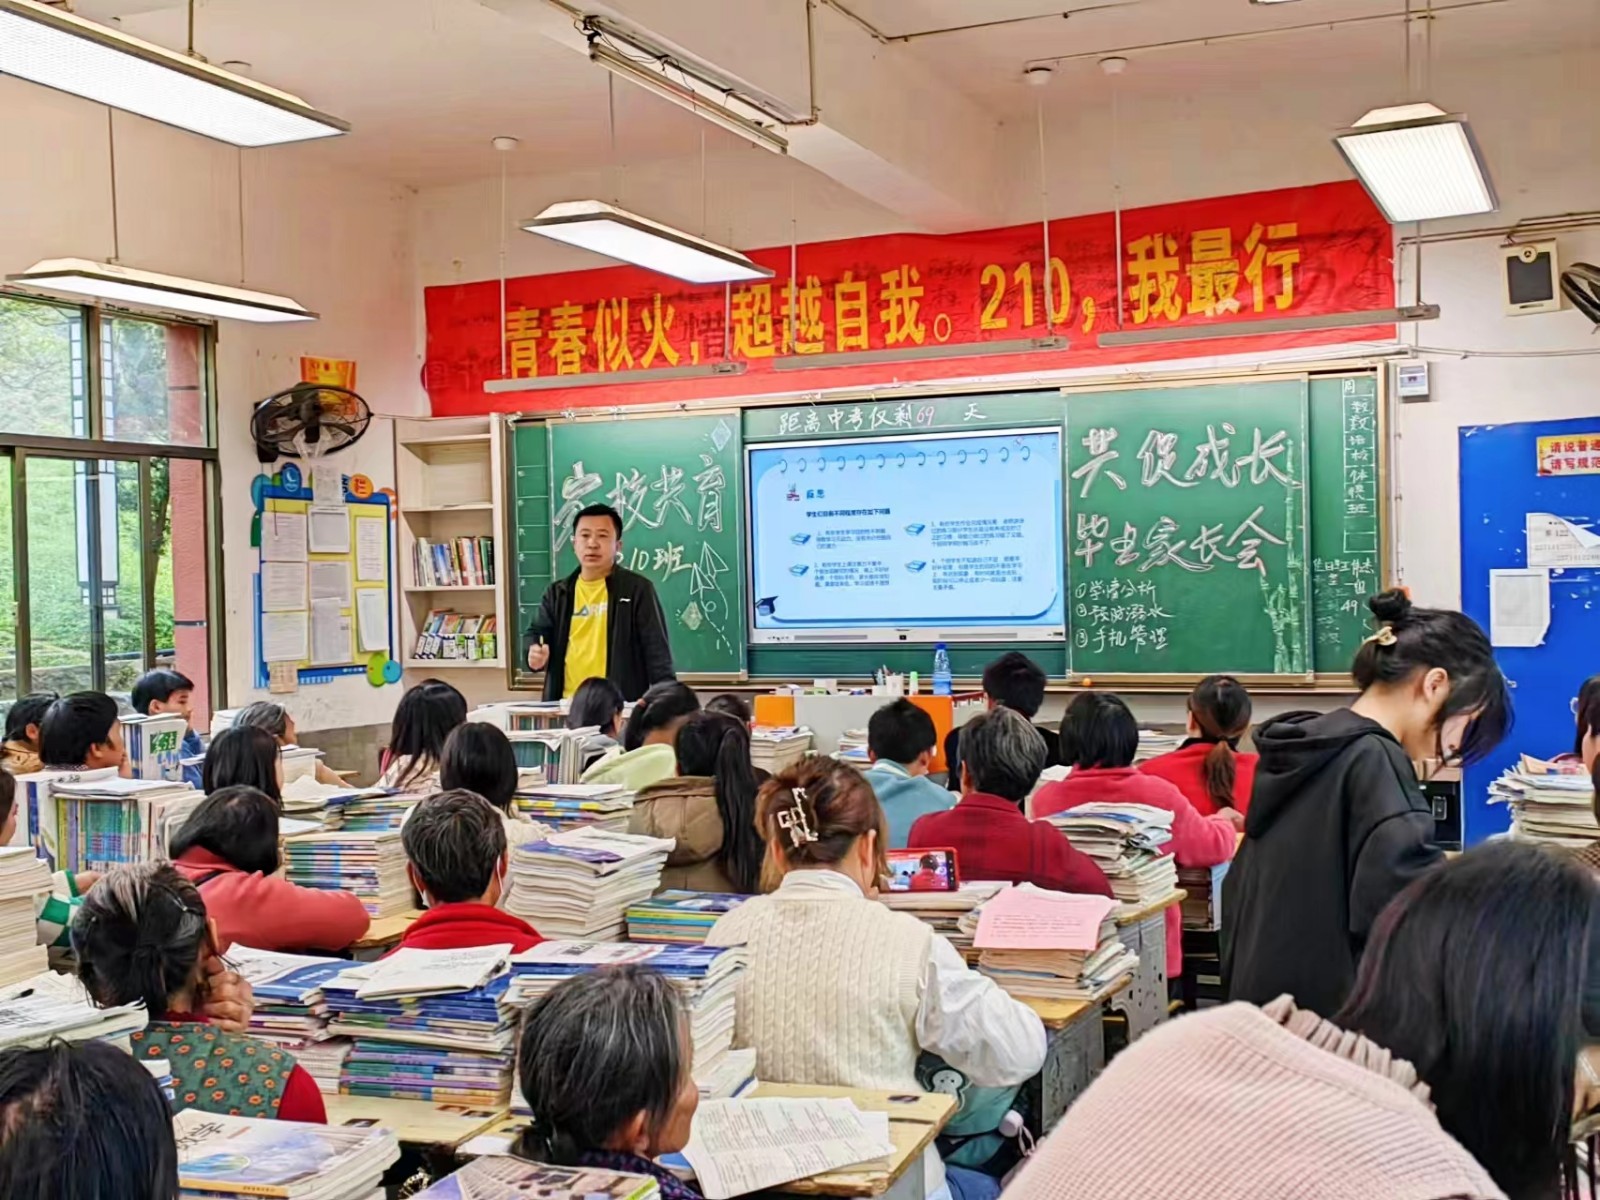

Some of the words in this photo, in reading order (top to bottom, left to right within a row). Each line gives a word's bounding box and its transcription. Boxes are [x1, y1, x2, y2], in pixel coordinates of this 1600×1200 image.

[963, 402, 988, 421] 天
[1072, 421, 1302, 498] 共促成长
